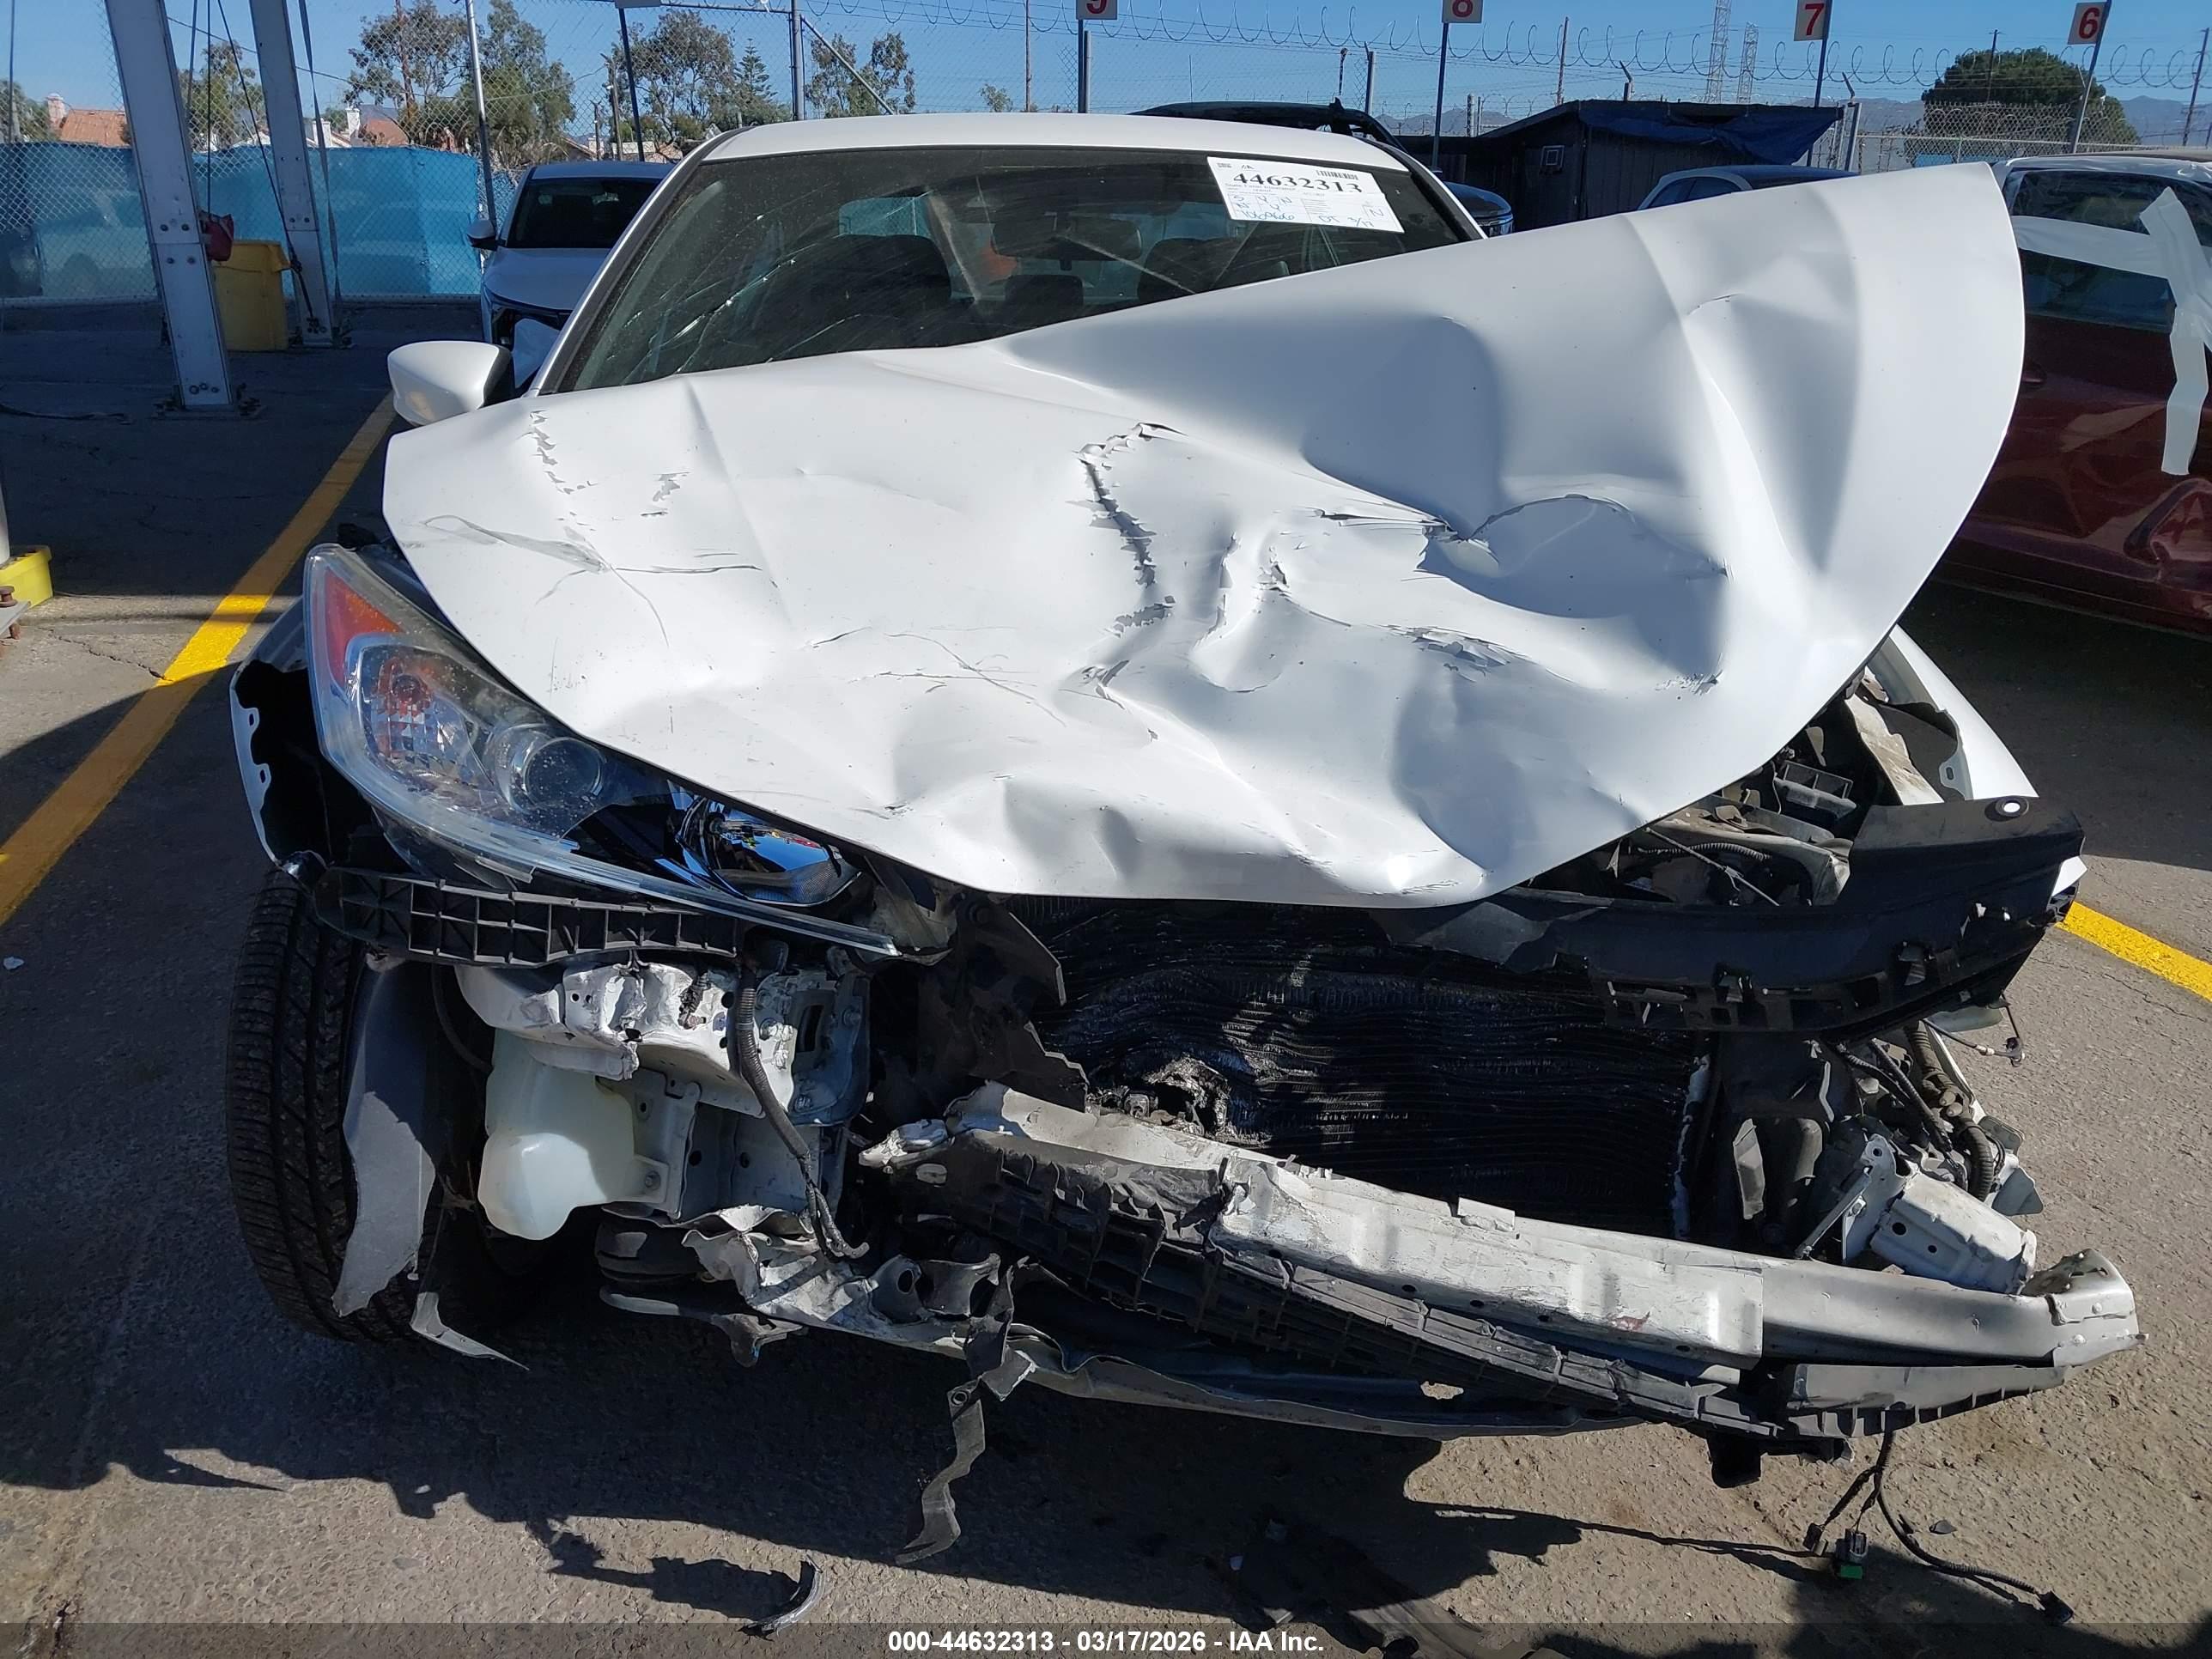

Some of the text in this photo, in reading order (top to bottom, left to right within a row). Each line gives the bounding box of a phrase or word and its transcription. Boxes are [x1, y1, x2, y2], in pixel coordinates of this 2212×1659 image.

[1805, 3, 1825, 36] 7
[2079, 7, 2100, 40] 6
[1233, 173, 1363, 193] 44632313
